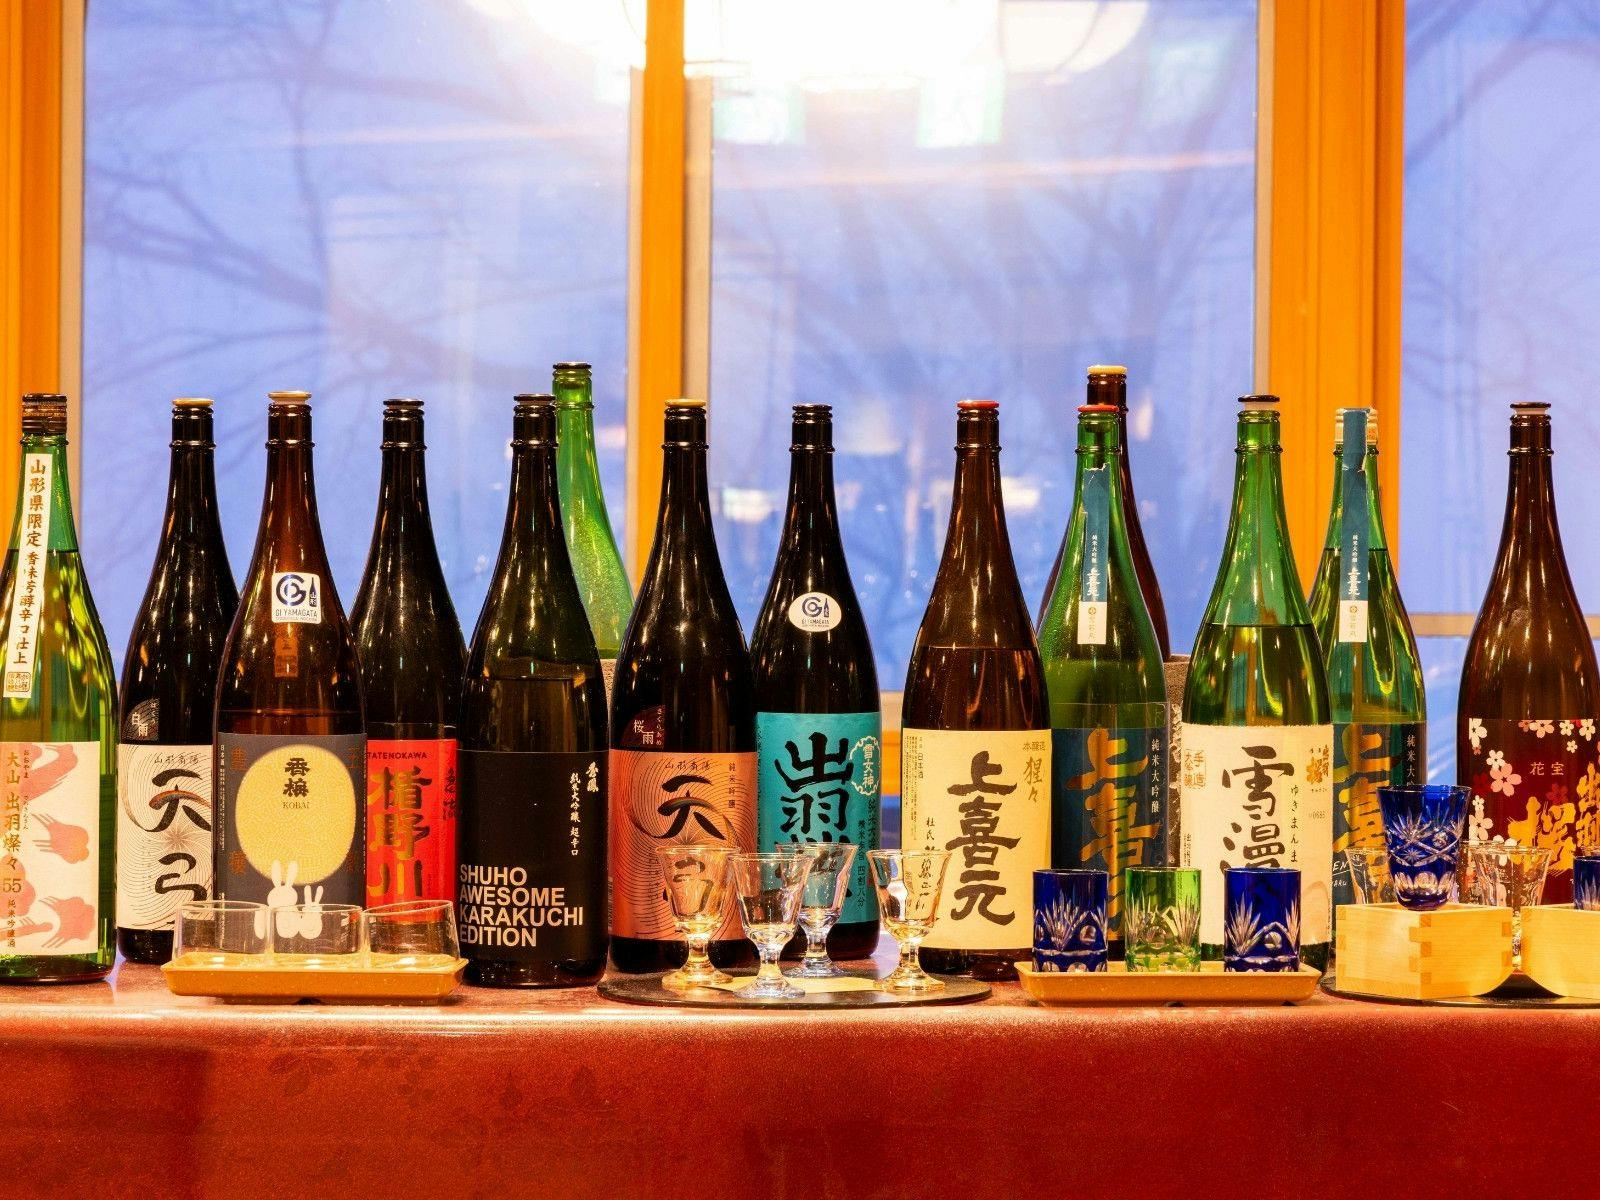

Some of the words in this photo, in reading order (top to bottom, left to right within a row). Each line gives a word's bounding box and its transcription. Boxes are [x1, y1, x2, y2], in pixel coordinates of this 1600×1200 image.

[26, 459, 46, 547] 山形県限定
[284, 608, 318, 618] YAMAGATA
[634, 719, 654, 745] 桜雨
[367, 751, 428, 760] TATENOKAWA
[862, 744, 875, 789] 雪女神
[1406, 734, 1416, 786] 純米大
[1151, 738, 1160, 814] 純米大吟醸
[1529, 761, 1565, 776] 花宝
[1218, 744, 1295, 873] 雪漫
[1290, 784, 1300, 863] ゆきまんま
[945, 750, 1022, 926] 上喜元
[2, 878, 22, 893] 55
[460, 863, 528, 886] SHUHO
[459, 885, 566, 907] AWESOME
[459, 904, 584, 927] KARAKUCHI
[459, 924, 538, 947] EDITION
